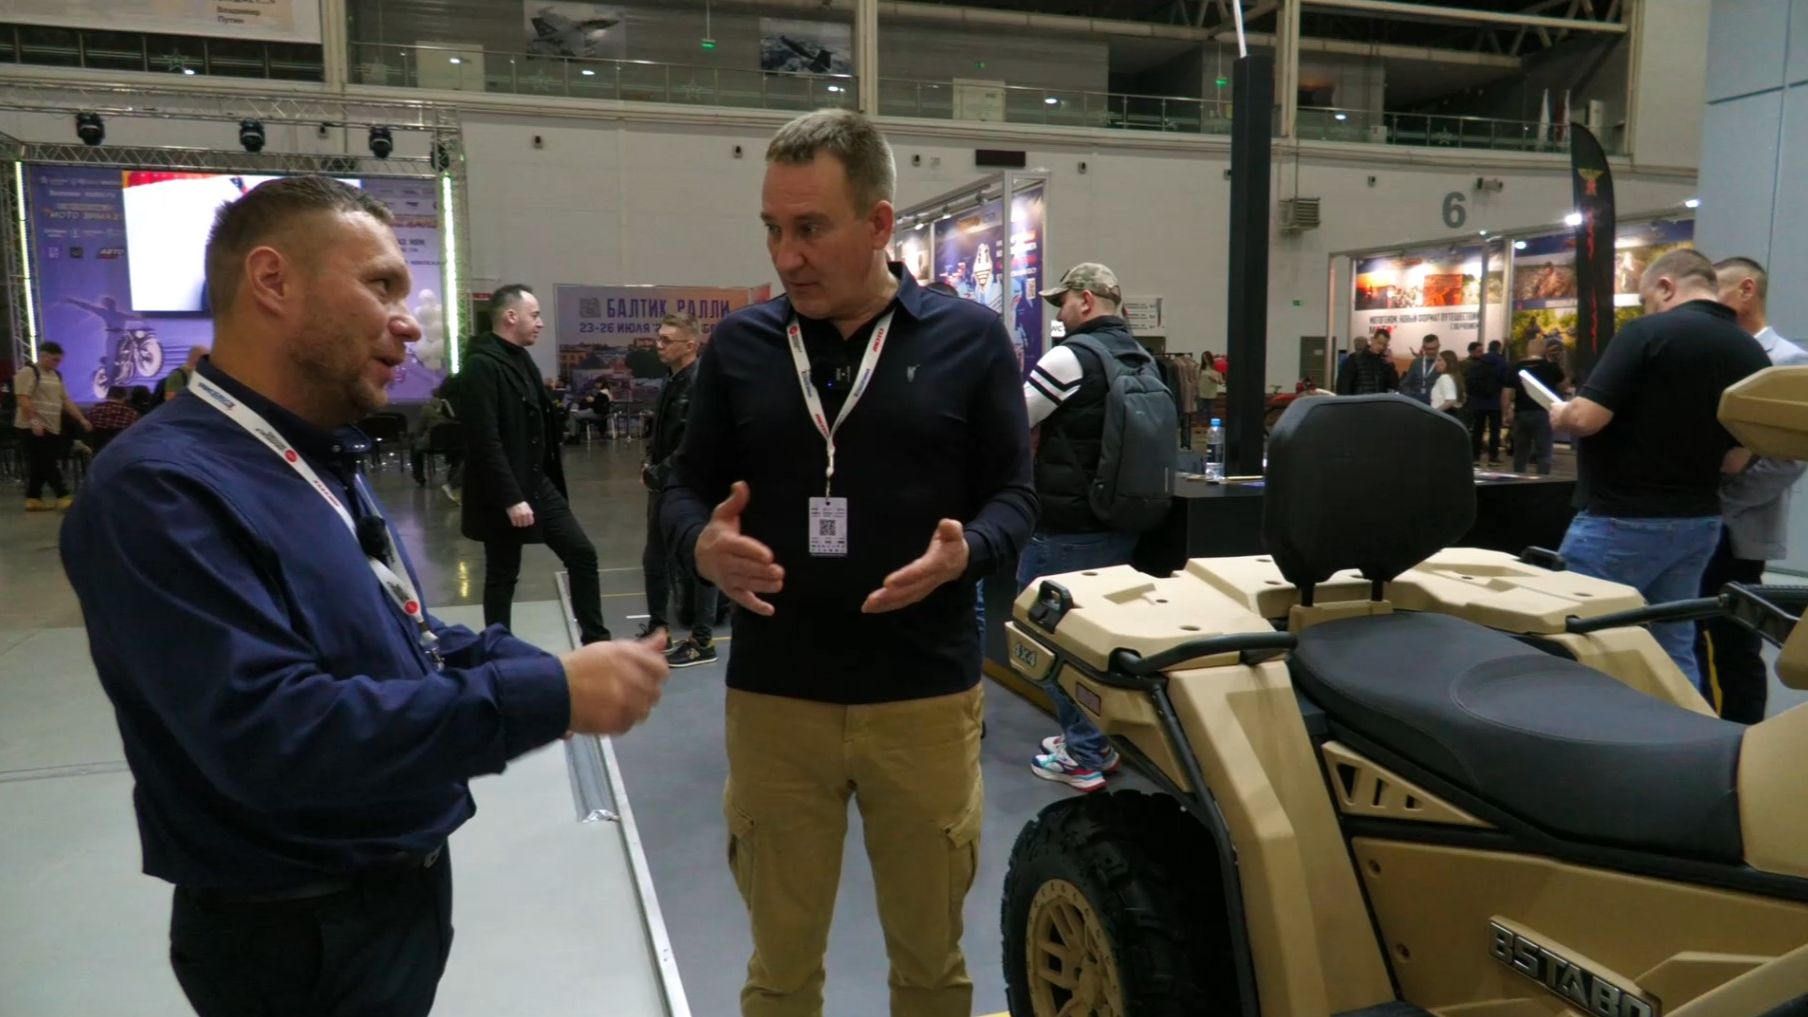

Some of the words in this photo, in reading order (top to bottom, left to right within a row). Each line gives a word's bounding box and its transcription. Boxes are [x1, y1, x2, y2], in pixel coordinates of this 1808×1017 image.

[1442, 191, 1467, 229] 6
[607, 299, 667, 318] БАЛТИК
[677, 299, 731, 319] РАЛЛИ
[580, 322, 615, 333] 23-26
[617, 322, 650, 334] ИЮЛЯ
